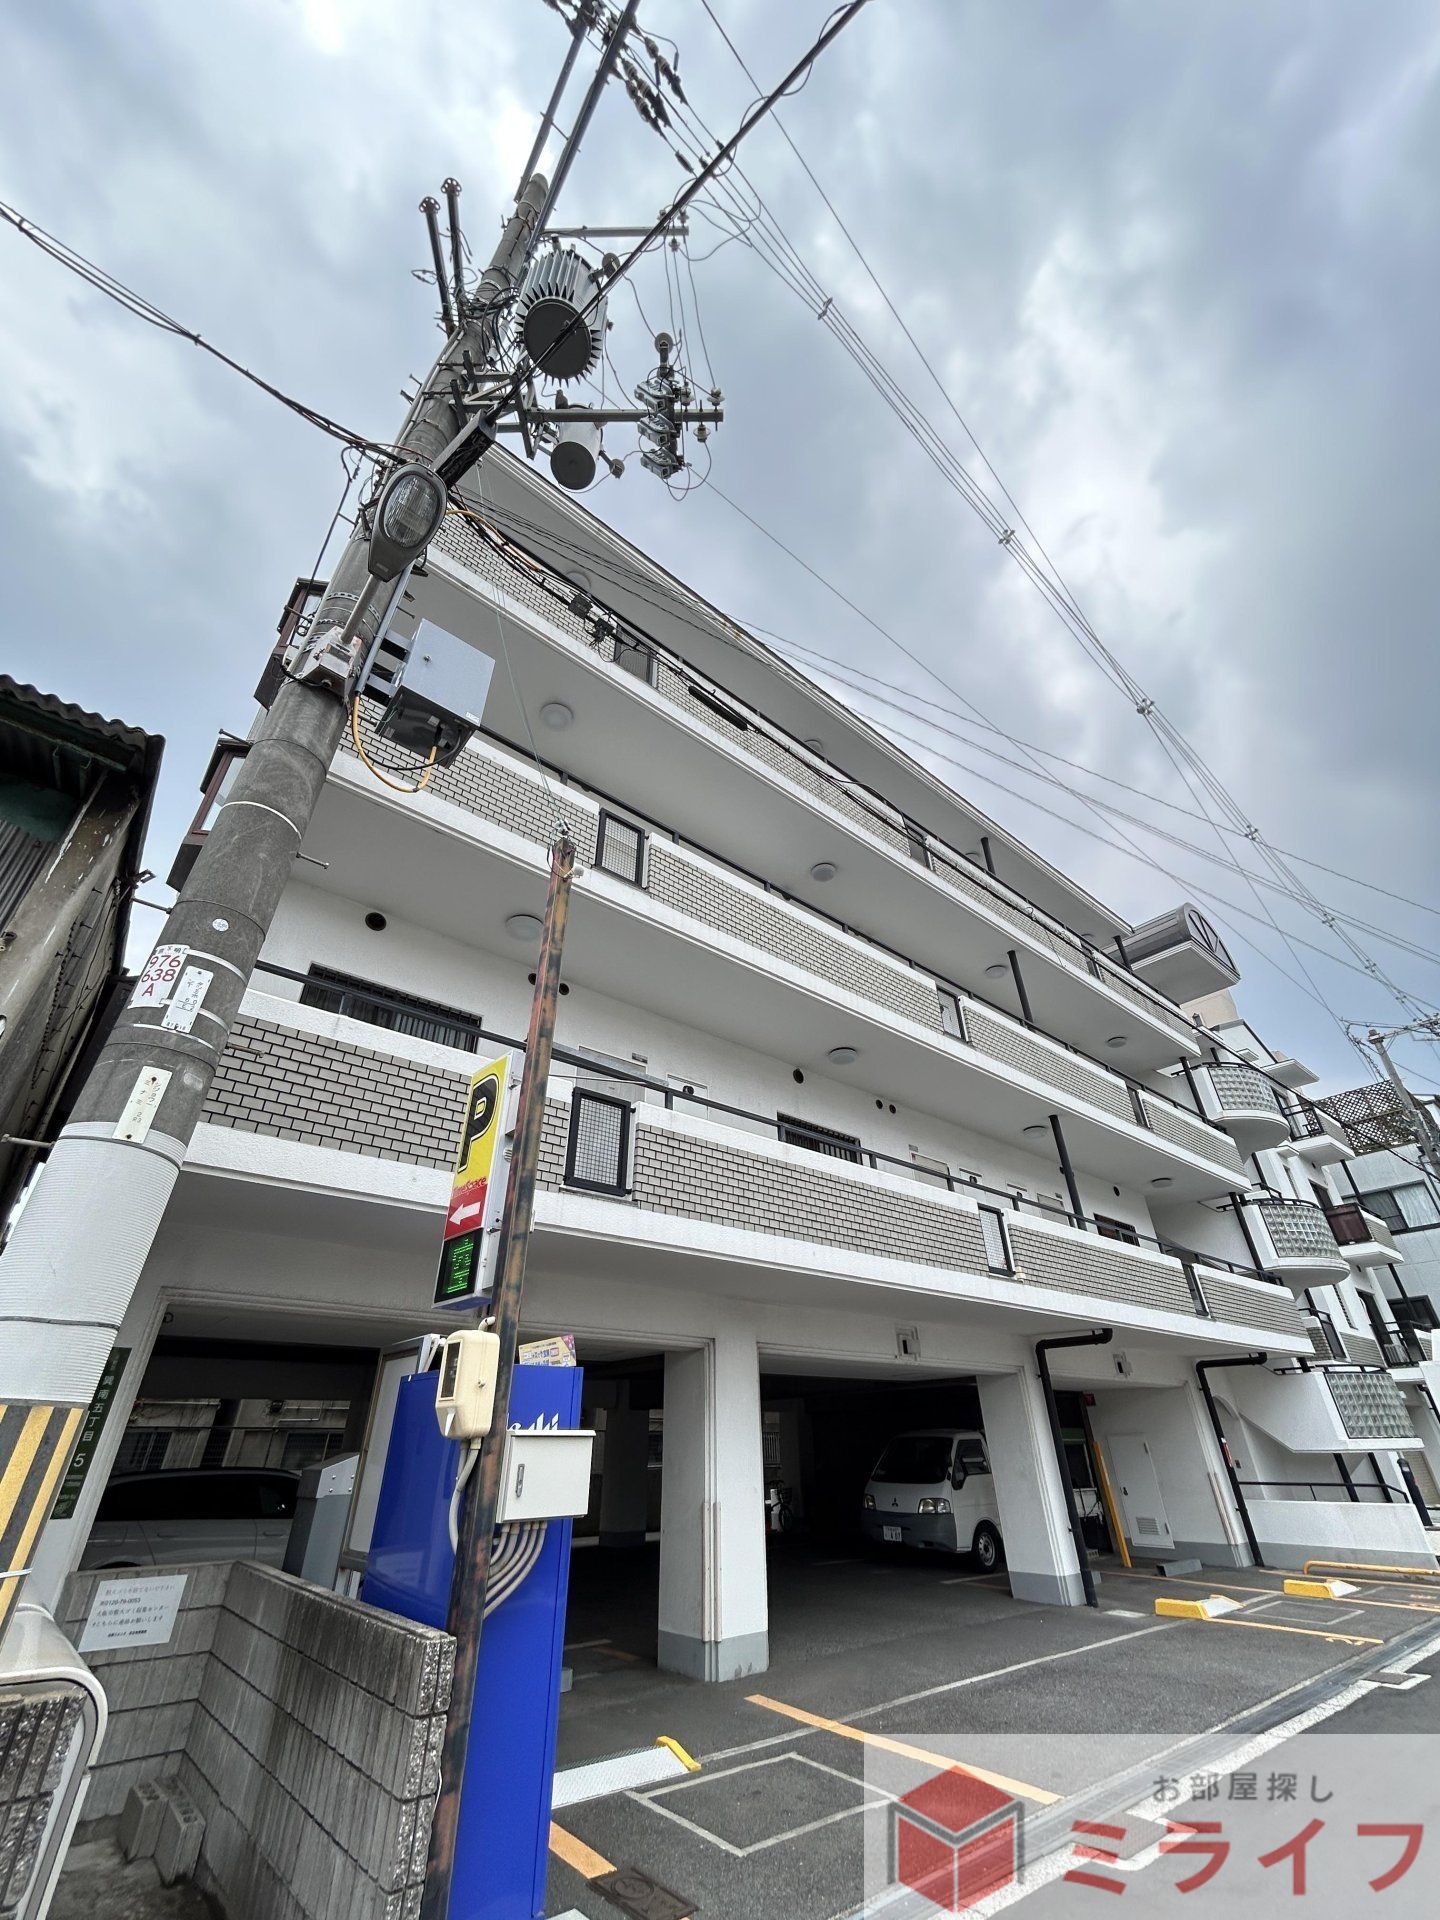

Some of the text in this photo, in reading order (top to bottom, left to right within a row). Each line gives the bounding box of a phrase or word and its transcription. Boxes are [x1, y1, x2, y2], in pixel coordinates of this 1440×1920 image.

[149, 954, 181, 969] 976
[141, 968, 177, 983] 638
[141, 982, 155, 997] A
[457, 1073, 500, 1174] P
[73, 1453, 86, 1468] 5
